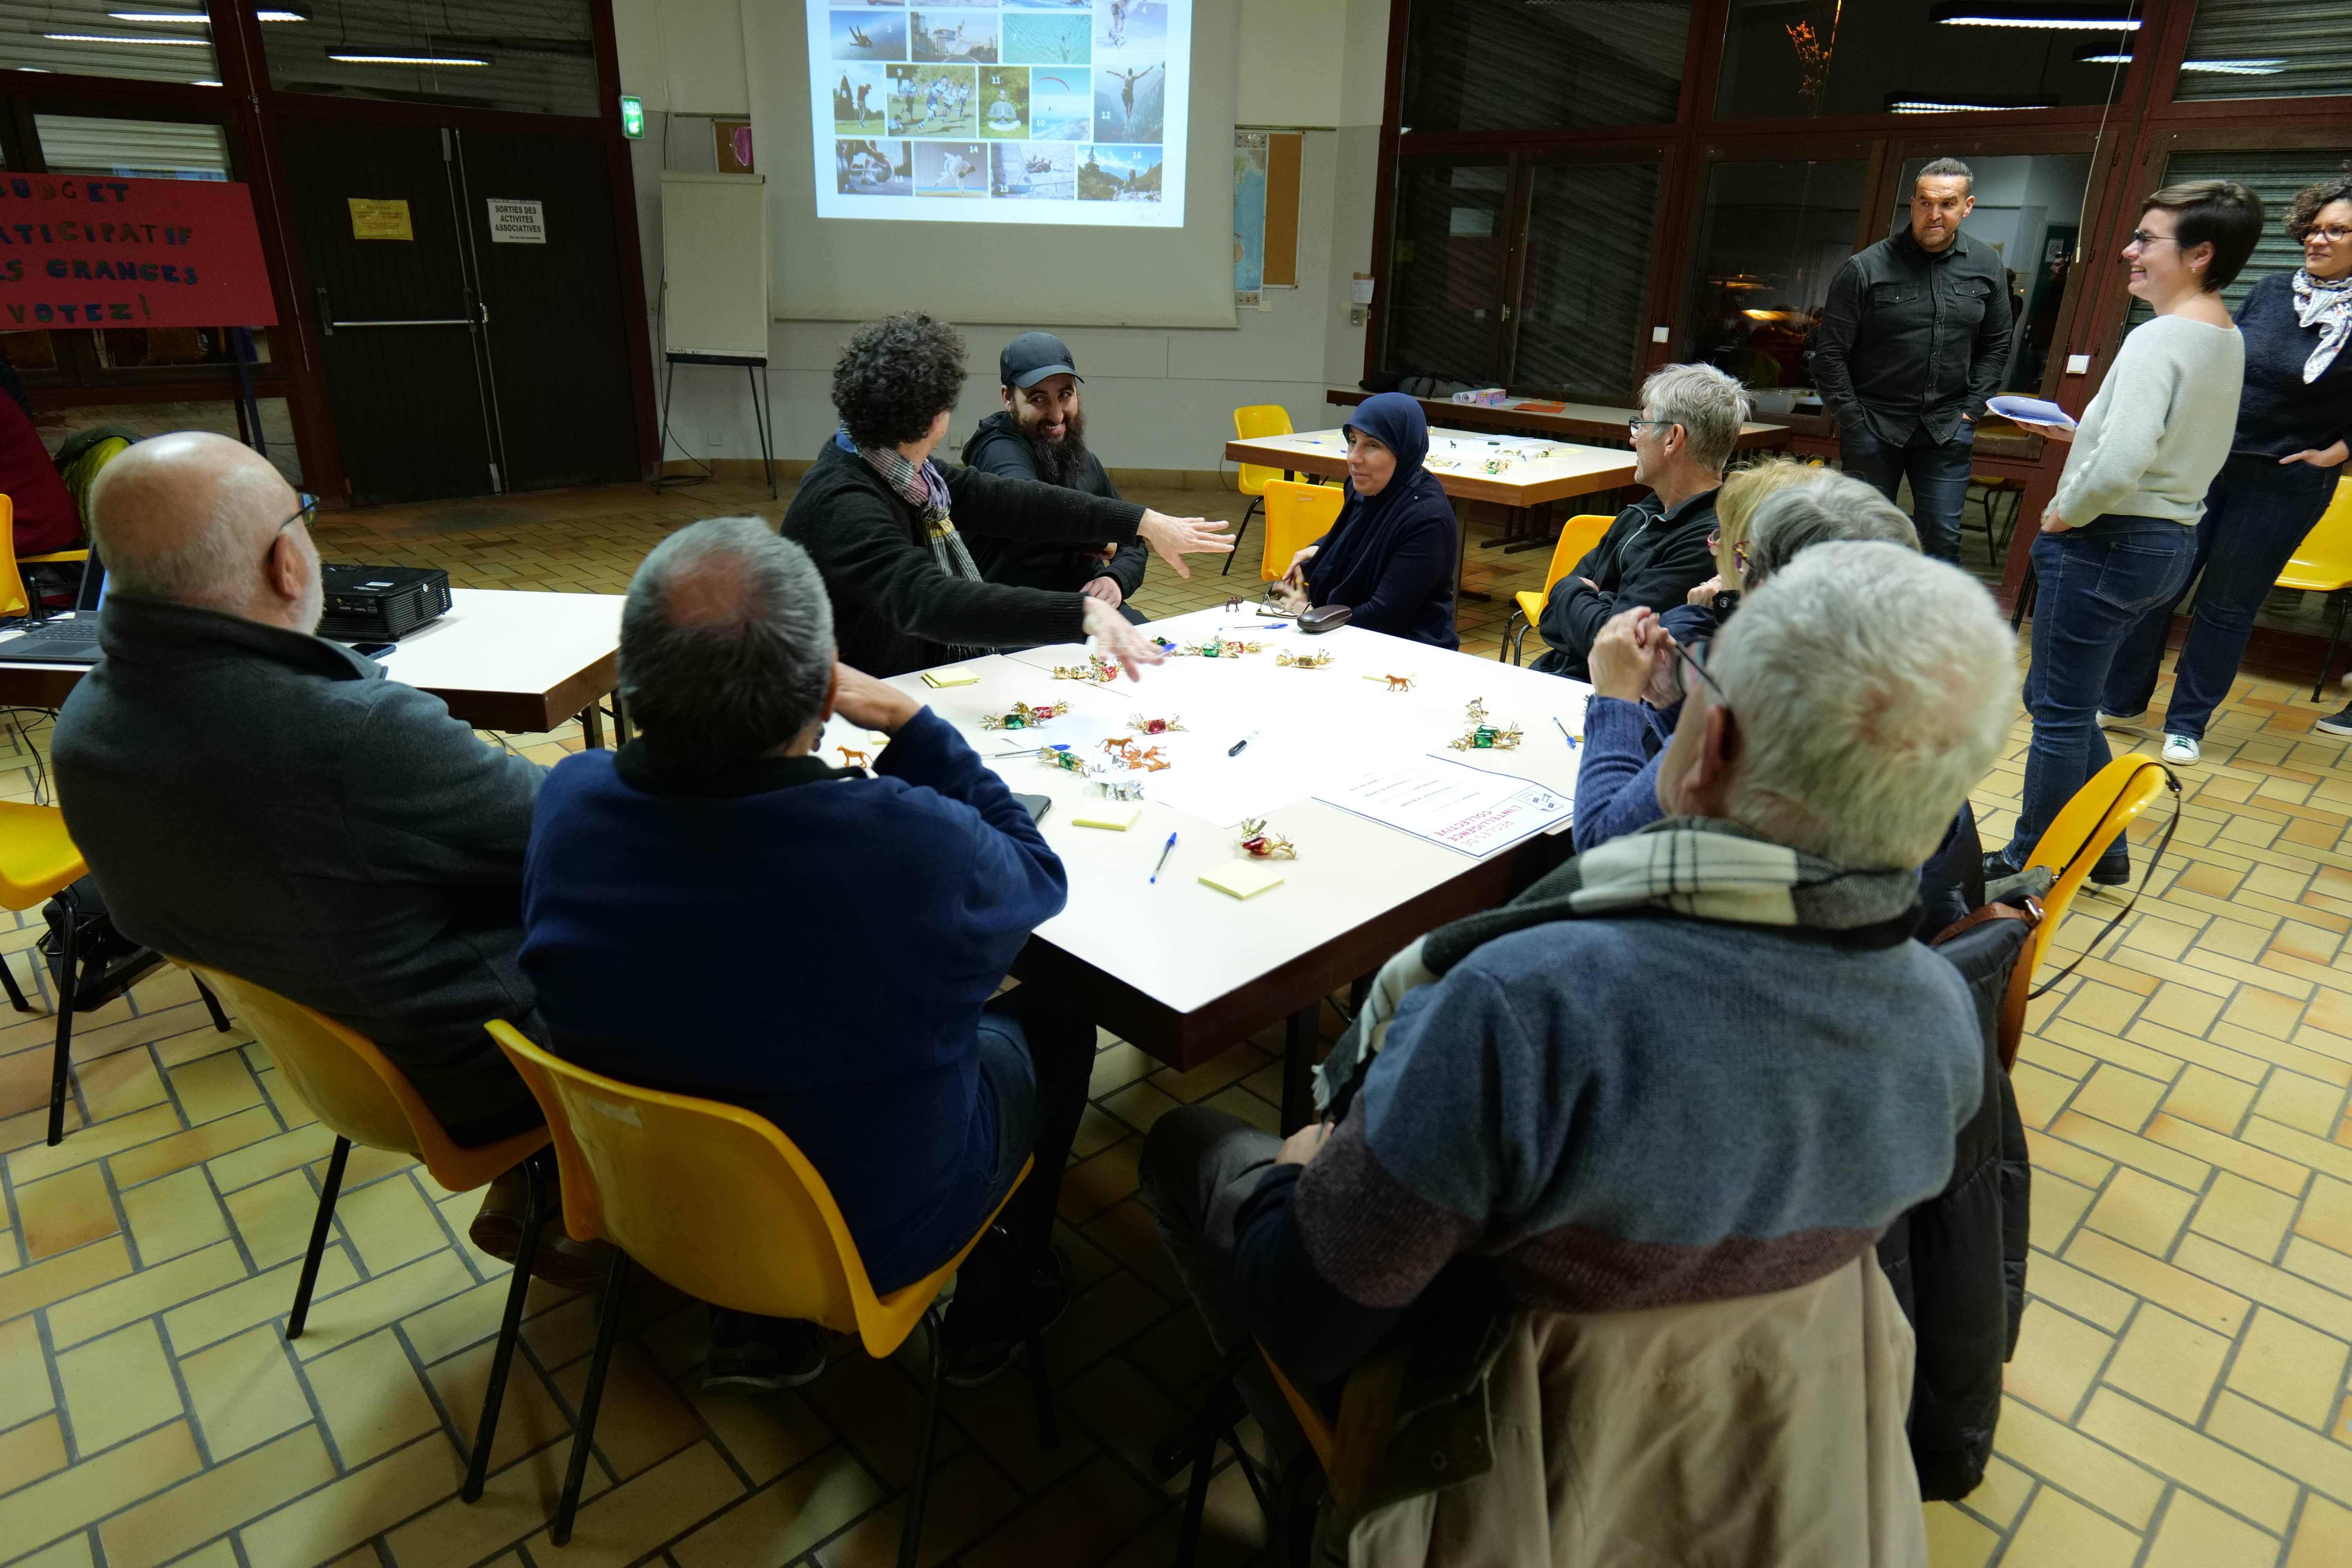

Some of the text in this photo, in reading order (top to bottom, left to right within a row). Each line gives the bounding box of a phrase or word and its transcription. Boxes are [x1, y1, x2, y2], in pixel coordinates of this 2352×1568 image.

[887, 24, 892, 33] 5
[897, 68, 902, 76] 9
[991, 76, 1001, 84] 11
[0, 179, 129, 201] UDGET
[495, 205, 522, 214] SORTIES
[495, 224, 541, 232] ASSOCIATIVES
[46, 259, 198, 285] GRANGES
[7, 294, 151, 323] VOTEZ!
[1433, 810, 1492, 837] COLLECTIVE
[1447, 805, 1522, 842] L'INTELLIGENCE
[1461, 838, 1479, 847] DE
